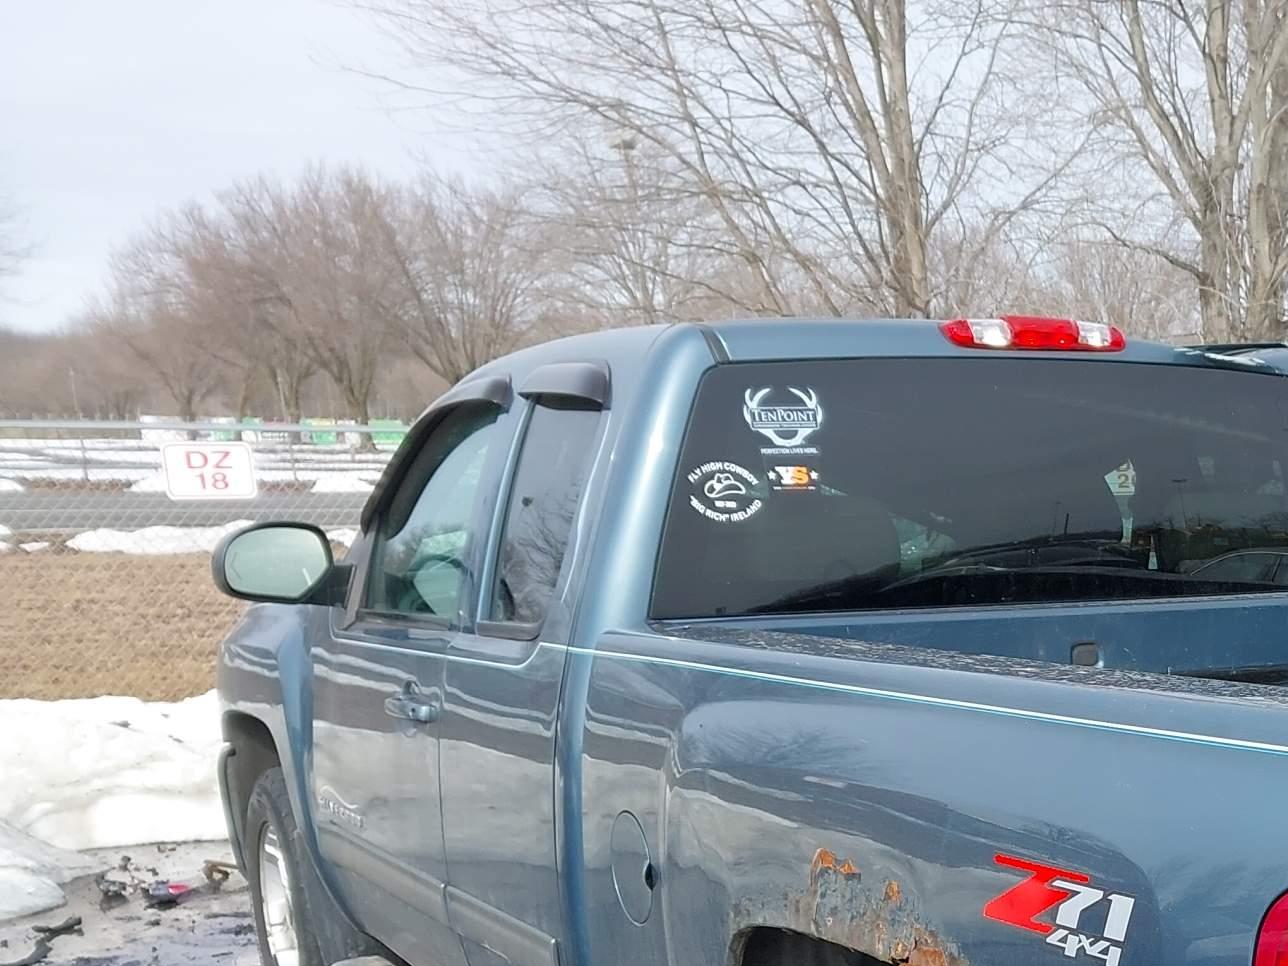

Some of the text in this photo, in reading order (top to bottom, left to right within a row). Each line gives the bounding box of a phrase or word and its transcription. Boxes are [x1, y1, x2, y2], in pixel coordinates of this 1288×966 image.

[184, 450, 233, 469] DZ
[196, 472, 229, 490] 18
[687, 461, 760, 486] FLY HIGH COWBOY
[730, 499, 762, 522] IRELAND
[983, 853, 1135, 943] Z71
